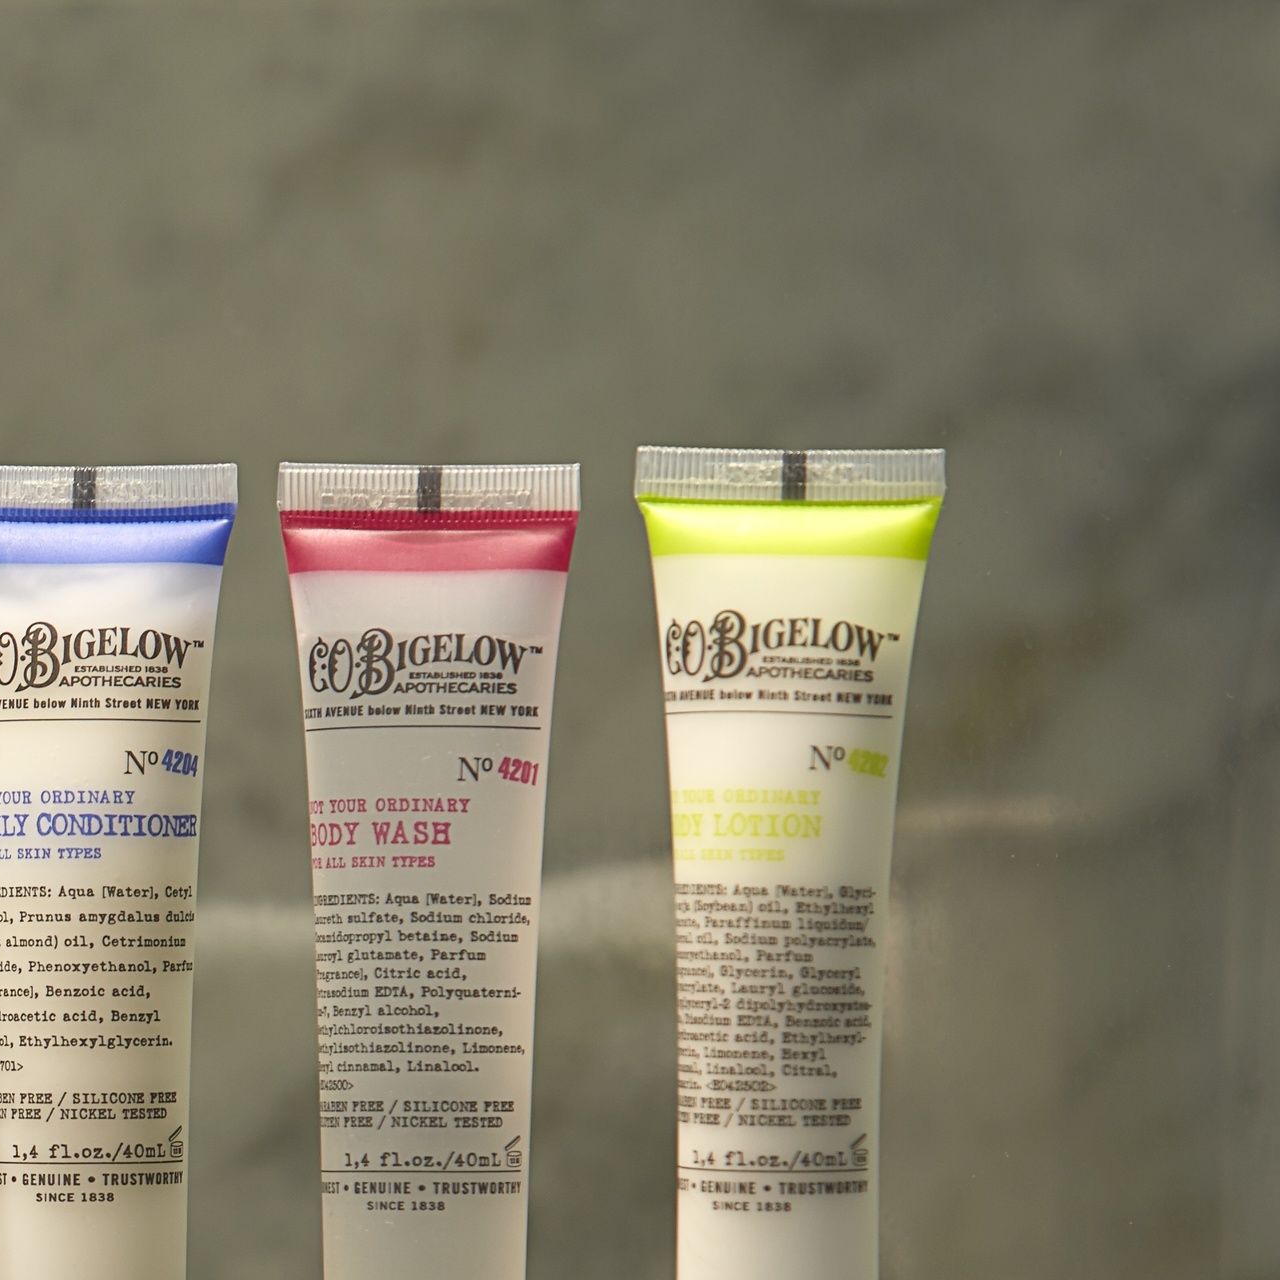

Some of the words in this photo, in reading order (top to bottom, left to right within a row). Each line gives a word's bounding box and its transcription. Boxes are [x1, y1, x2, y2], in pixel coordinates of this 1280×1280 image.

[746, 667, 873, 682] APOTHECARIES
[59, 676, 181, 688] APOTHECARIES
[393, 682, 517, 694] APOTHECARIES
[34, 698, 66, 709] below
[71, 698, 101, 709] Ninth
[105, 699, 141, 709] Street
[146, 699, 170, 709] NEW
[175, 700, 199, 710] YORK
[325, 706, 363, 717] AVENUE
[368, 705, 400, 716] below
[405, 705, 435, 715] Ninth
[440, 705, 475, 716] Street
[480, 706, 505, 716] NEW
[511, 706, 538, 717] YORK
[162, 749, 198, 777] 4204
[498, 757, 539, 785] 4201
[41, 791, 135, 804] ORDINARY
[330, 800, 367, 813] YOUR
[376, 799, 471, 813] ORDINARY
[37, 813, 197, 837] CONDITIONER
[713, 814, 822, 837] LOTION
[311, 822, 359, 846] BODY
[372, 821, 451, 845] WASH
[17, 849, 51, 859] SKIN
[58, 848, 101, 859] TYPES
[326, 857, 346, 868] ALL
[352, 856, 385, 867] SKIN
[393, 856, 436, 867] TYPES
[59, 886, 94, 898] Aqua
[166, 887, 192, 899] Cetyl
[20, 912, 71, 922] Prunus
[79, 911, 159, 924] amygdalus
[6, 936, 58, 948] almond)
[64, 936, 94, 949] oil,
[29, 961, 157, 974] Phenoxyethanol,
[46, 986, 105, 997] Benzoic
[112, 986, 150, 999] acid,
[63, 1011, 103, 1023] acid,
[111, 1010, 160, 1024] Benzyl
[20, 1036, 173, 1049] Ethylhexylglycerin.
[20, 1093, 53, 1104] FREE
[73, 1093, 144, 1104] SILICONE
[150, 1092, 177, 1103] FREE
[353, 1101, 384, 1112] FREE
[404, 1101, 477, 1112] SILICONE
[484, 1101, 514, 1112] FREE
[11, 1108, 41, 1119] FREE
[61, 1108, 116, 1119] NICKEL
[123, 1108, 167, 1119] TESTED
[344, 1117, 373, 1128] FREE
[391, 1117, 447, 1128] NICKEL
[454, 1118, 503, 1128] TESTED
[13, 1145, 38, 1159] 1,4
[345, 1153, 369, 1168] 1,4
[22, 1173, 80, 1185] GENUINE
[103, 1171, 183, 1185] TRUSTWORTHY
[354, 1182, 411, 1194] GENUINE
[433, 1182, 521, 1194] TRUSTWORTHY
[779, 1181, 867, 1195] TRUSTWORTHY
[36, 1193, 74, 1202] SINCE
[81, 1193, 114, 1202] 1838
[368, 1202, 404, 1211] SINCE
[412, 1202, 445, 1211] 1838
